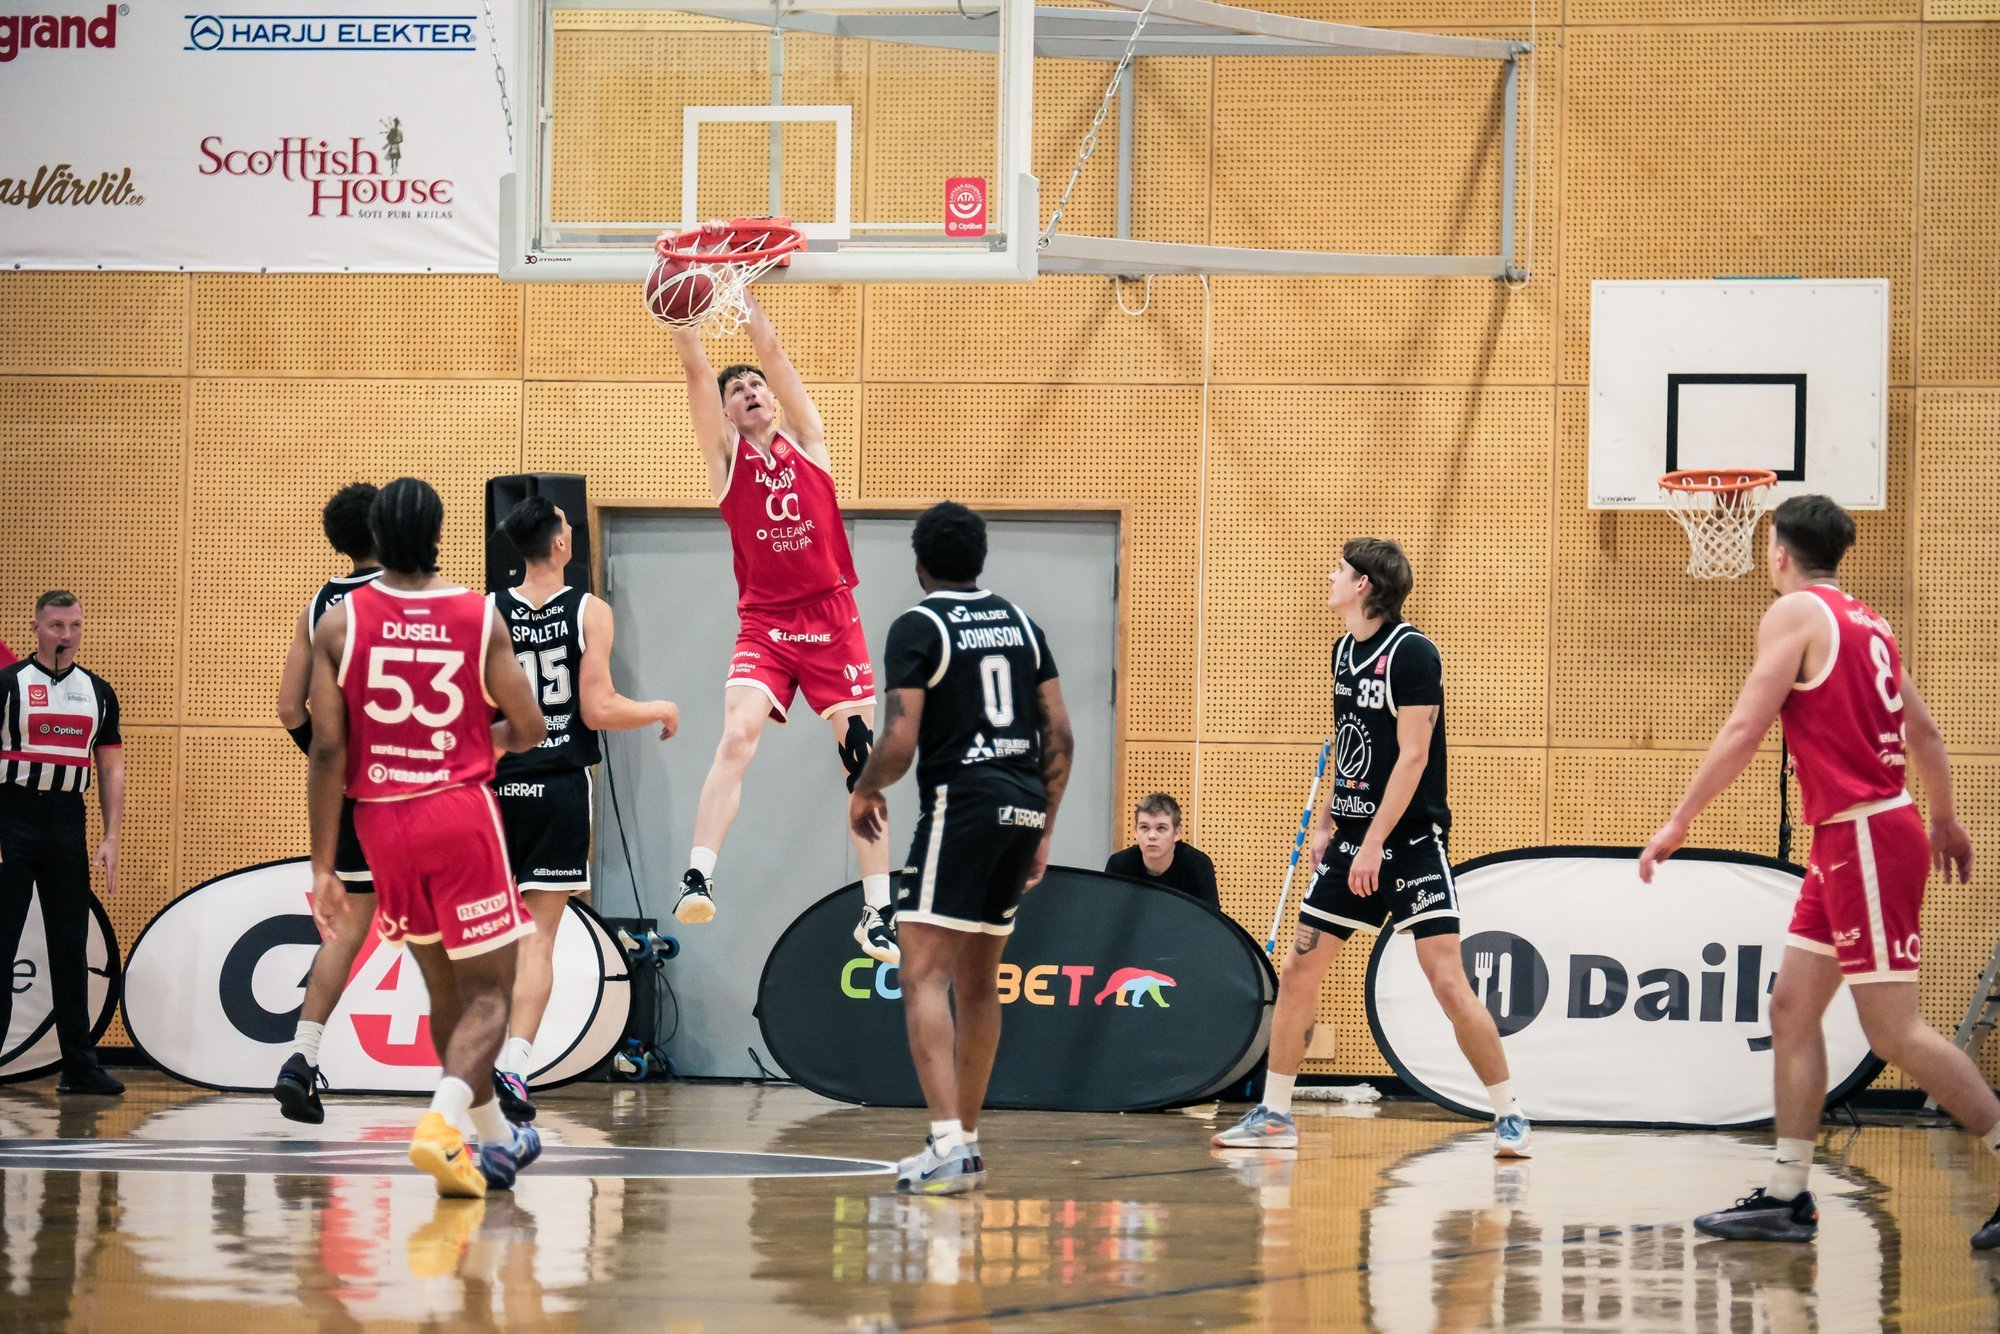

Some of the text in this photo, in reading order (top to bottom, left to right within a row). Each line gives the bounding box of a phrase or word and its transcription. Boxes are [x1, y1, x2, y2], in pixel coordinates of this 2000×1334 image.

[0, 4, 117, 62] grand
[232, 23, 471, 43] HARJU ELEKTER
[198, 135, 382, 182] Scottish
[388, 209, 411, 219] PUBI
[772, 535, 812, 552] GRUPA
[531, 605, 565, 621] VALDEK
[971, 609, 1009, 621] VALDEK
[382, 622, 452, 643] DUSELL
[512, 620, 569, 644] SPALETA
[957, 626, 1024, 650] JOHNSON
[516, 645, 572, 706] 15
[1869, 634, 1904, 713] 8
[363, 646, 465, 728] 53
[979, 654, 1014, 728] 0
[1357, 677, 1387, 710] 33
[53, 724, 83, 736] Optibet
[546, 867, 583, 876] betoneks
[841, 957, 1095, 1007] COBET
[1567, 942, 1777, 1052] Dail
